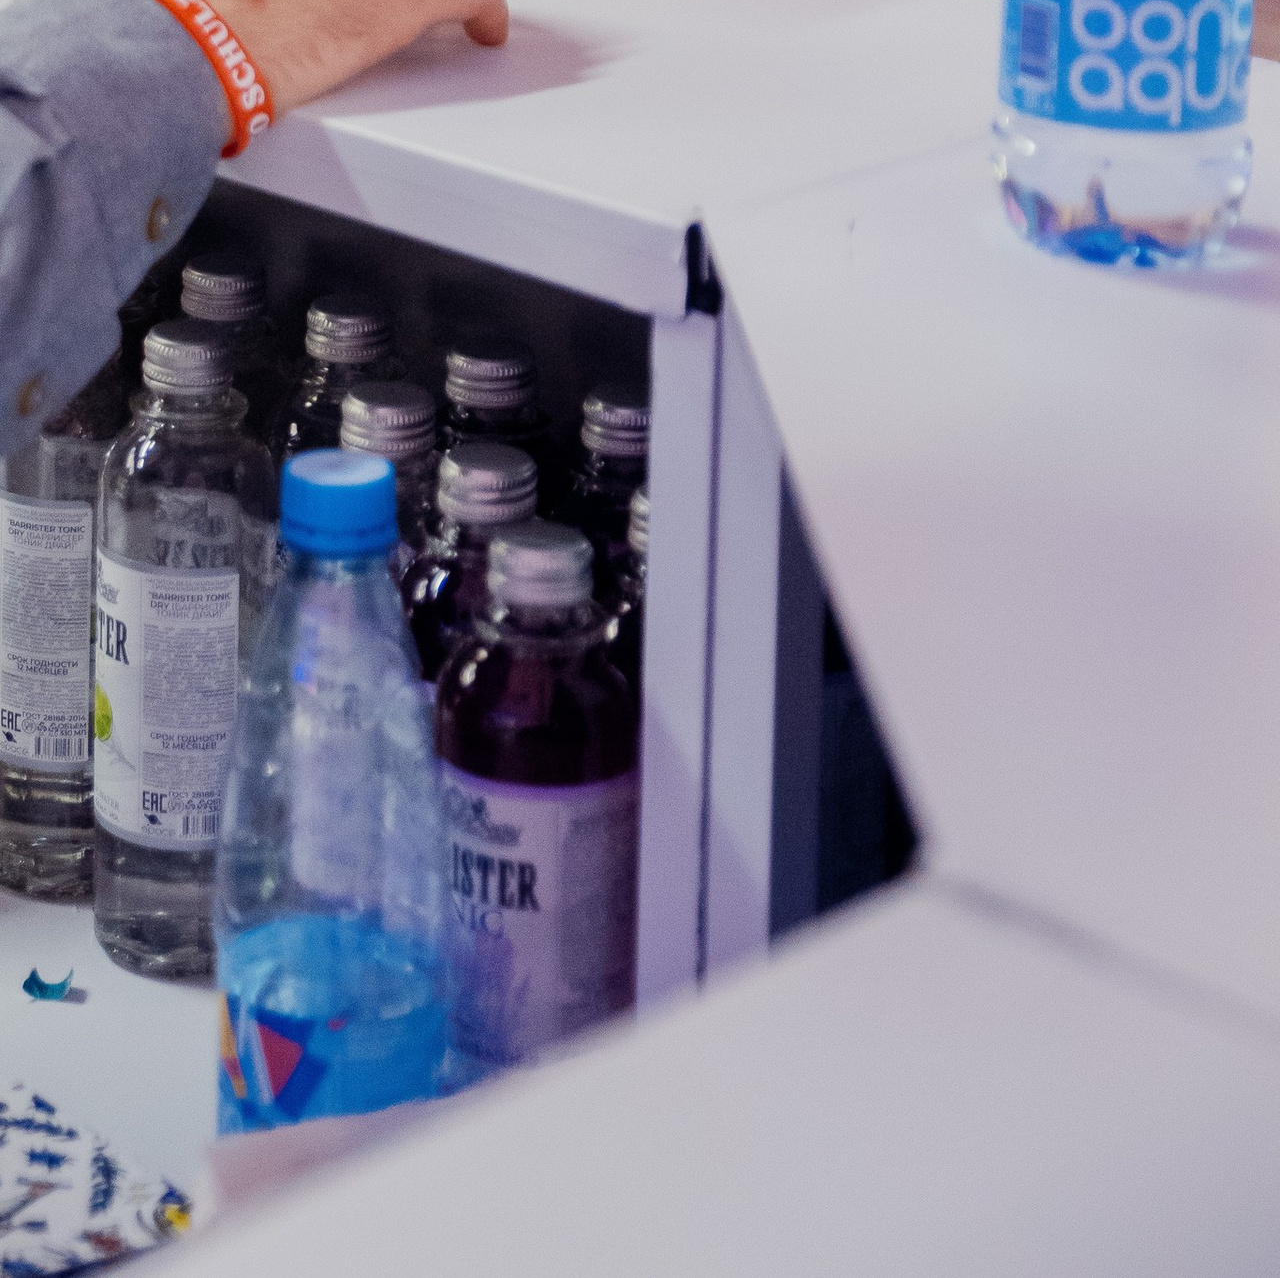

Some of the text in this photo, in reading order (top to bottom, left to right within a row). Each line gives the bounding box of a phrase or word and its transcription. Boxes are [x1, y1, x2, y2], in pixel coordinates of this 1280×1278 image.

[8, 526, 25, 536] DRY
[58, 526, 86, 534] TONIC
[150, 600, 169, 609] DRY
[7, 653, 79, 668] СРОК ГОДНОСТИ
[17, 663, 69, 676] 12 МЕСЯЦЕВ
[1, 708, 22, 733] EAC
[150, 731, 226, 742] СРОК ГОДНОСТИ
[172, 742, 217, 751] МЕСЯЦЕВ
[142, 790, 168, 814] EAC
